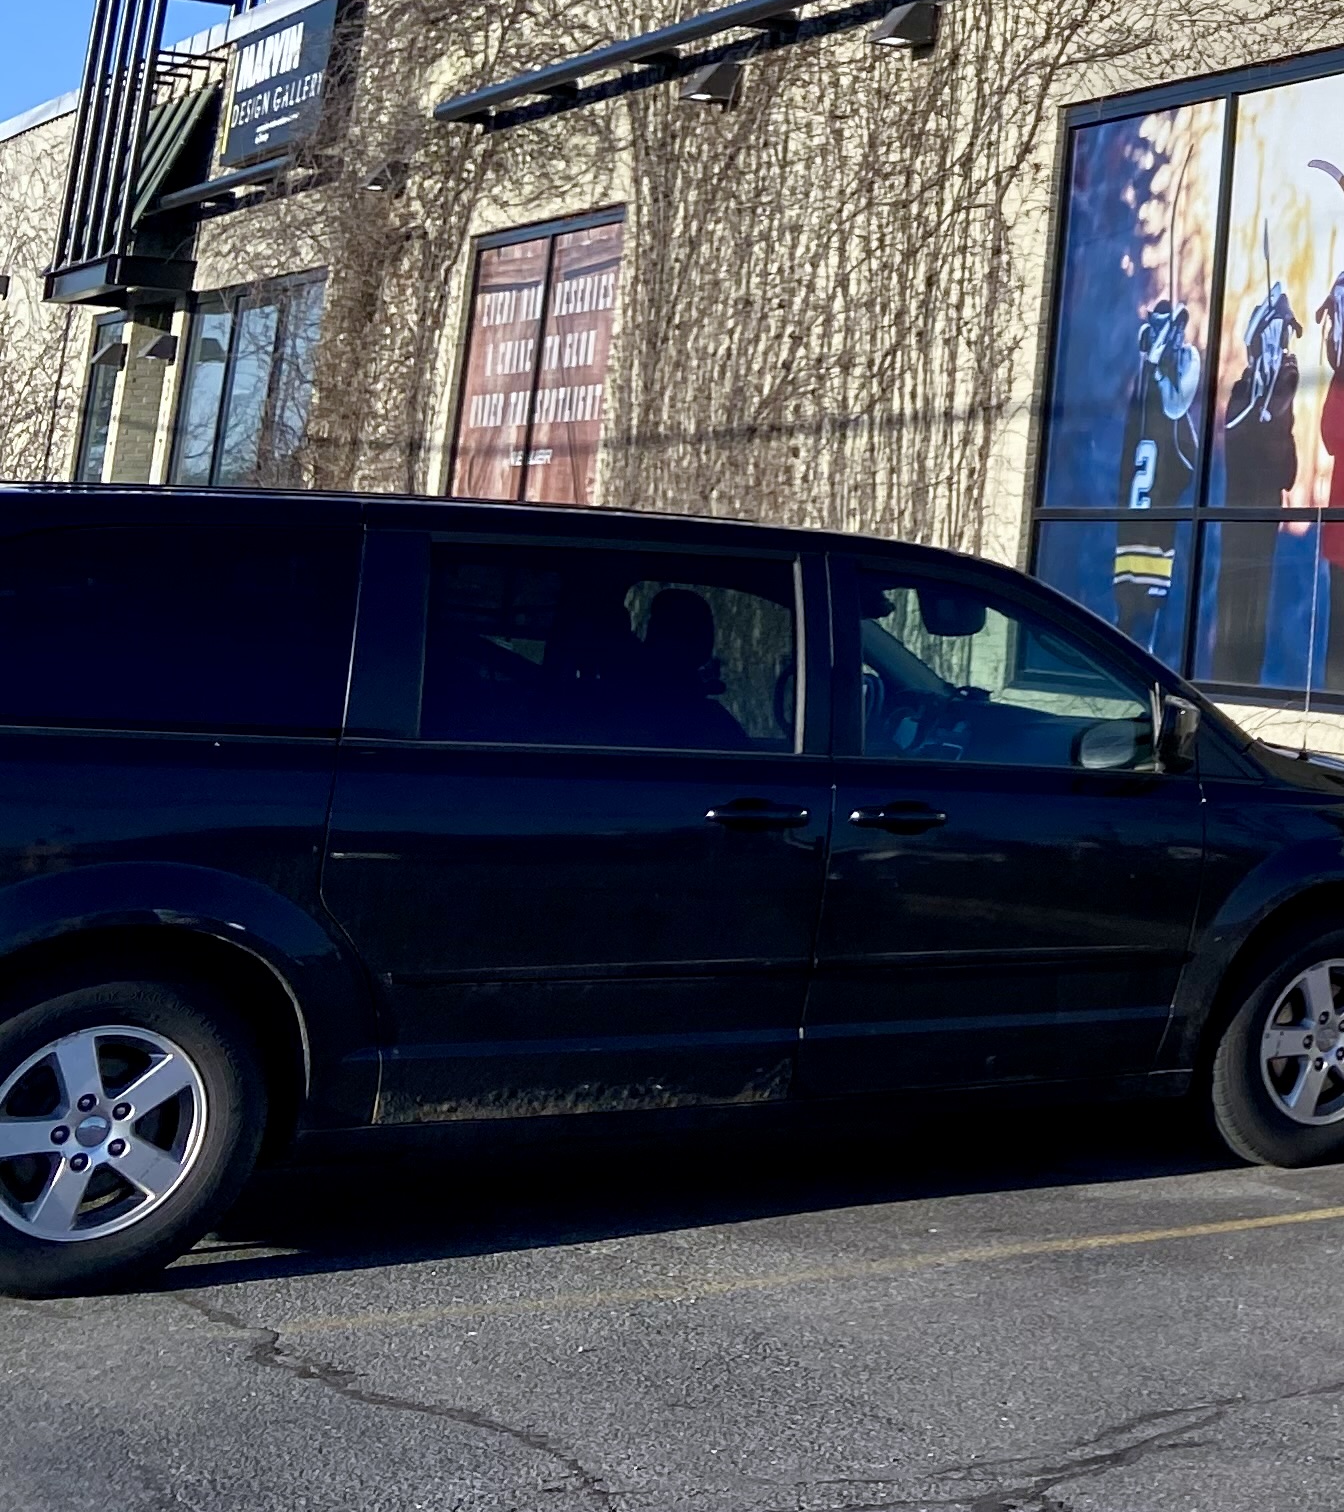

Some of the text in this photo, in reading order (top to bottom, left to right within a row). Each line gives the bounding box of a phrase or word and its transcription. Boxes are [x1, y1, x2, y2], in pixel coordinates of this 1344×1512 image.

[236, 22, 304, 93] MARVIN
[231, 91, 271, 128] DESIGN
[272, 69, 325, 112] GALLERY
[534, 383, 602, 424] SPOTLIGHT
[1128, 439, 1158, 509] 2
